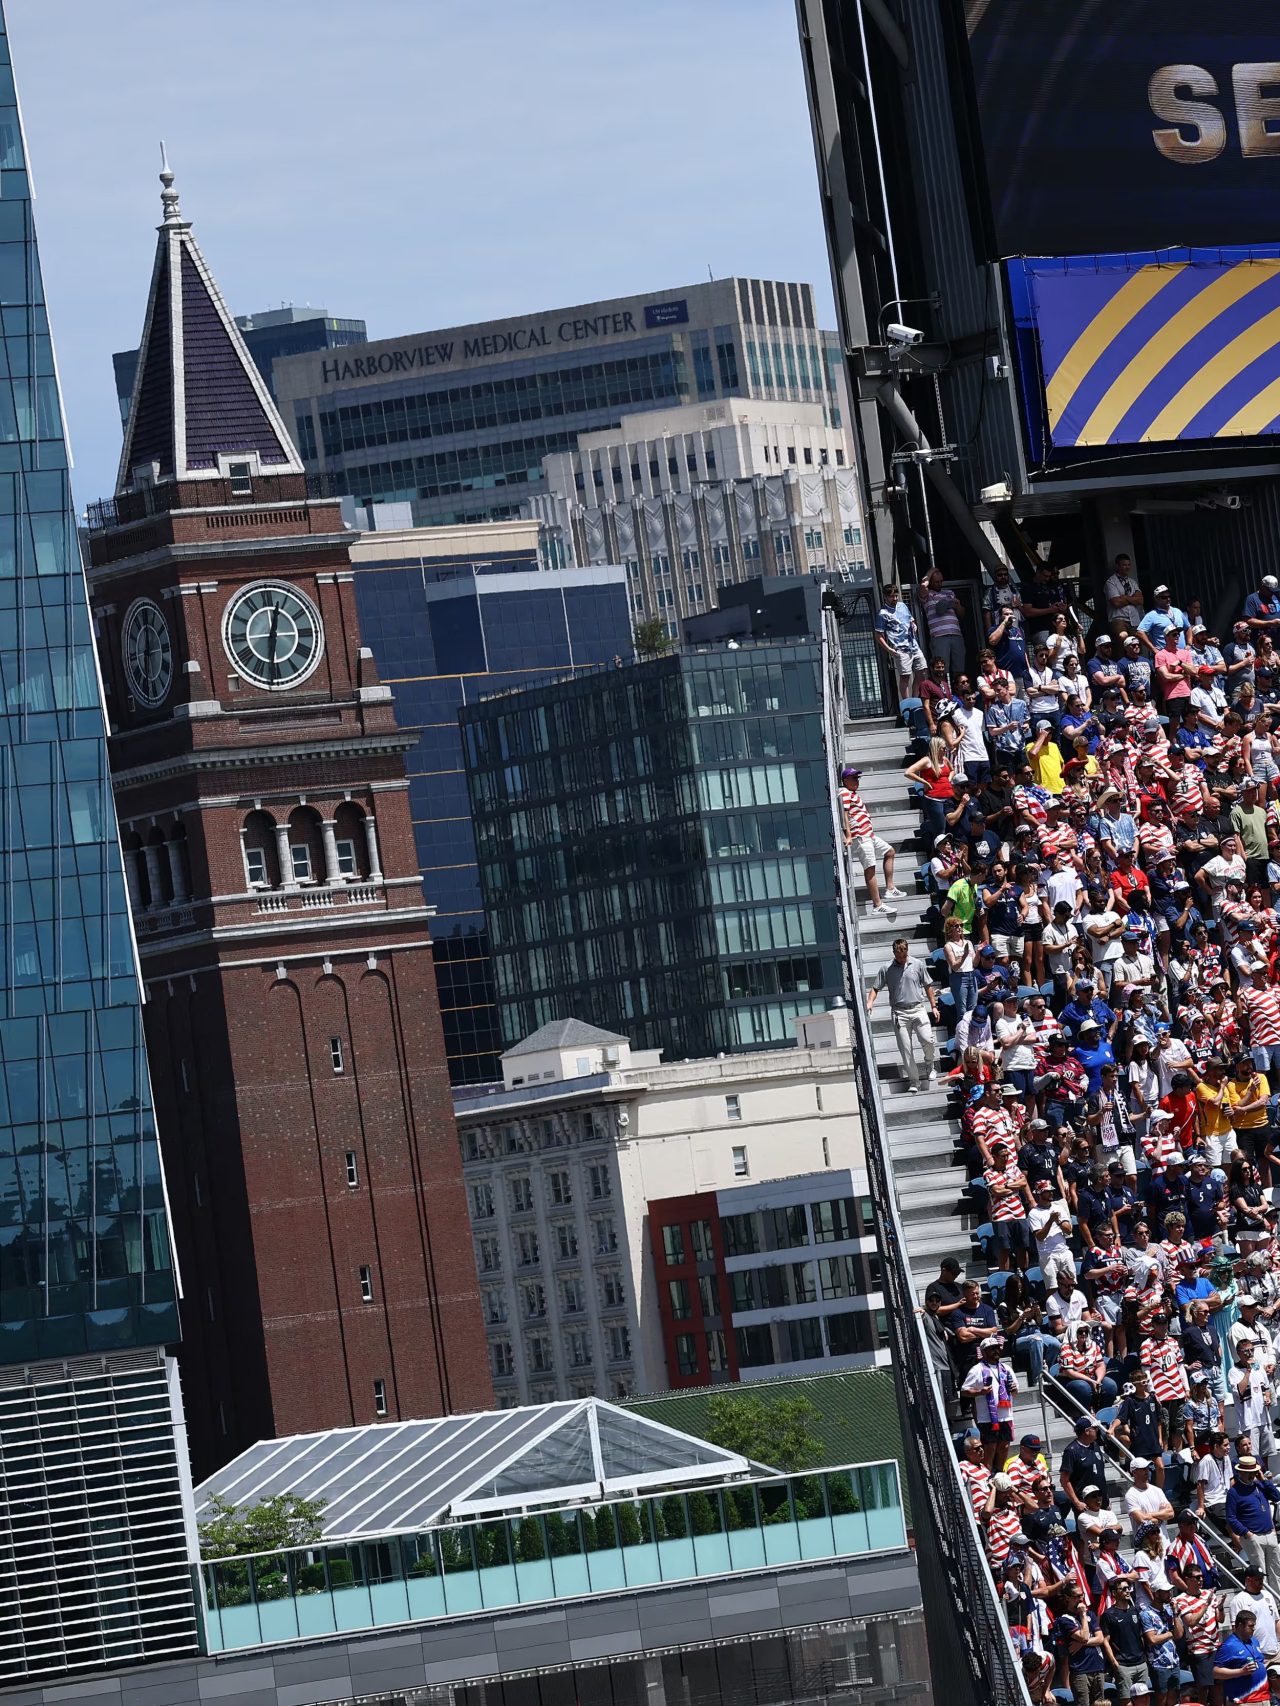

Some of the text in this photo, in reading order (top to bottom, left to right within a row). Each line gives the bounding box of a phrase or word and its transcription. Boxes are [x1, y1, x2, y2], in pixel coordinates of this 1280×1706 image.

[322, 311, 638, 383] HARBORVIEW MEDICAL CENTER
[1196, 1049, 1213, 1057] USA
[1199, 1191, 1204, 1202] 5
[1145, 1415, 1150, 1425] 8
[1268, 1606, 1274, 1616] 5
